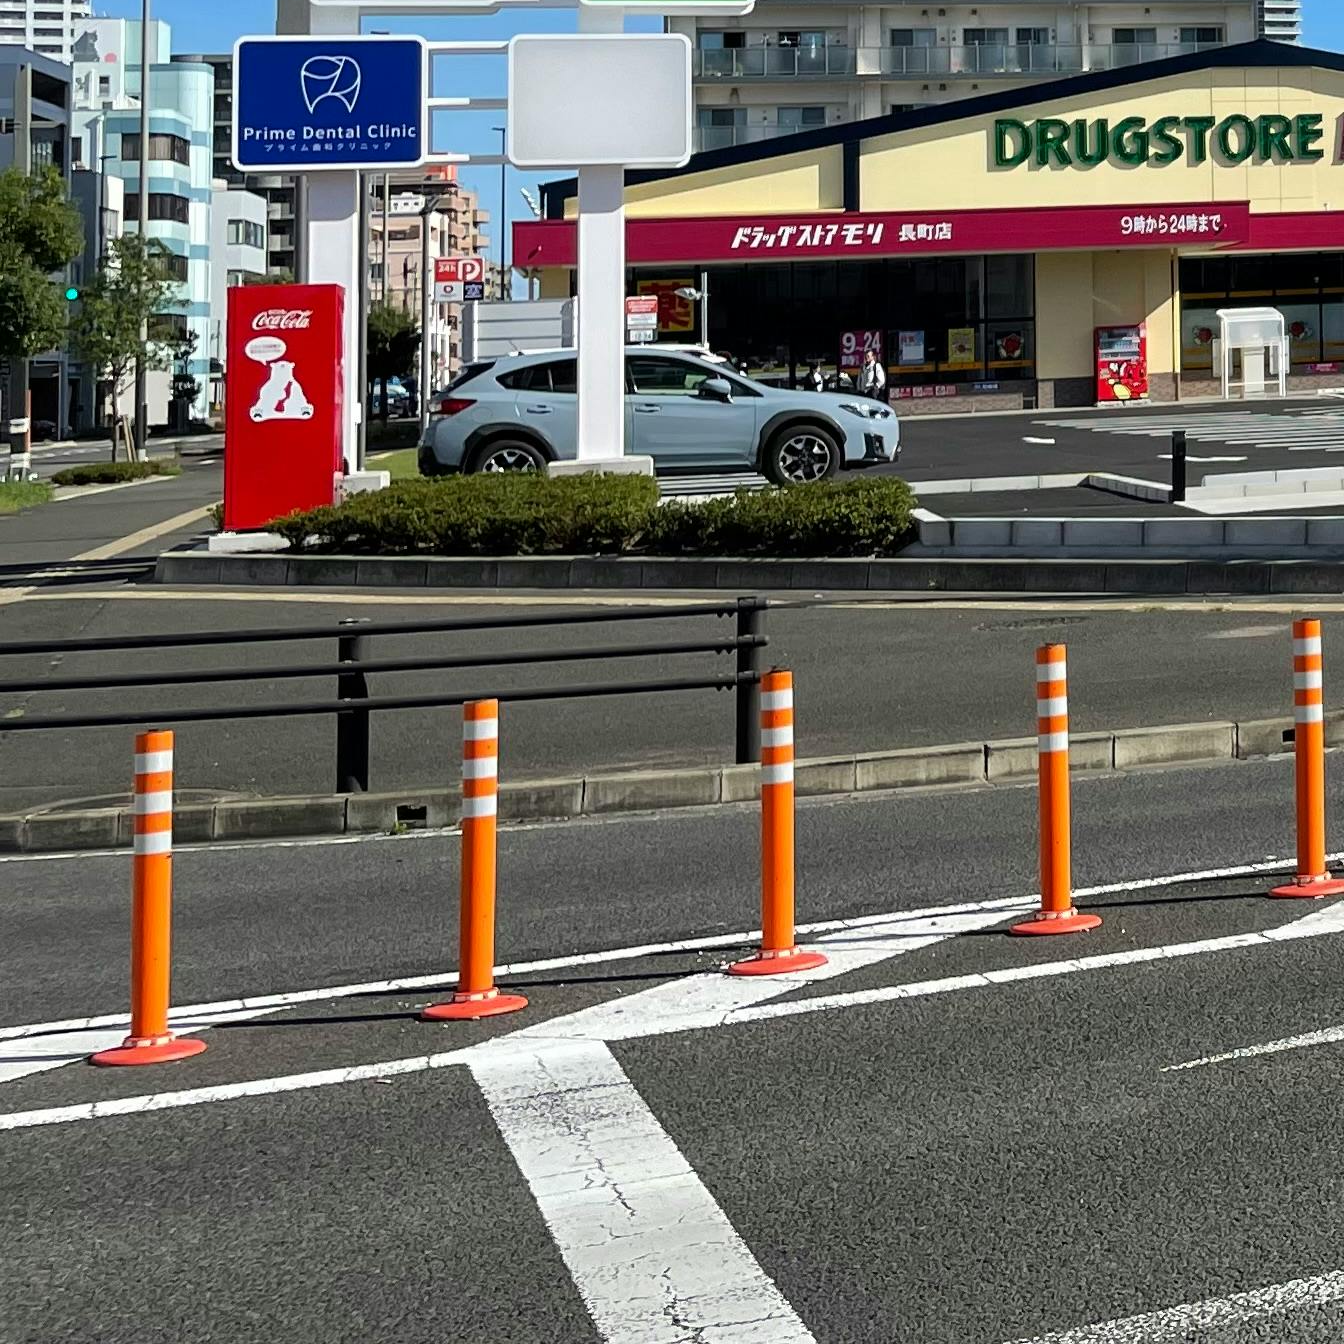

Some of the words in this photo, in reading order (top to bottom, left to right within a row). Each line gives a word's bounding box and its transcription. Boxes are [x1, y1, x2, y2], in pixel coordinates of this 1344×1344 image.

[244, 126, 296, 141] Prime
[303, 124, 361, 140] Dental
[368, 123, 417, 139] Clinic
[994, 113, 1324, 168] DRUGSTORE
[899, 222, 952, 241] 長町店
[1121, 213, 1221, 235] 9時から24時まで
